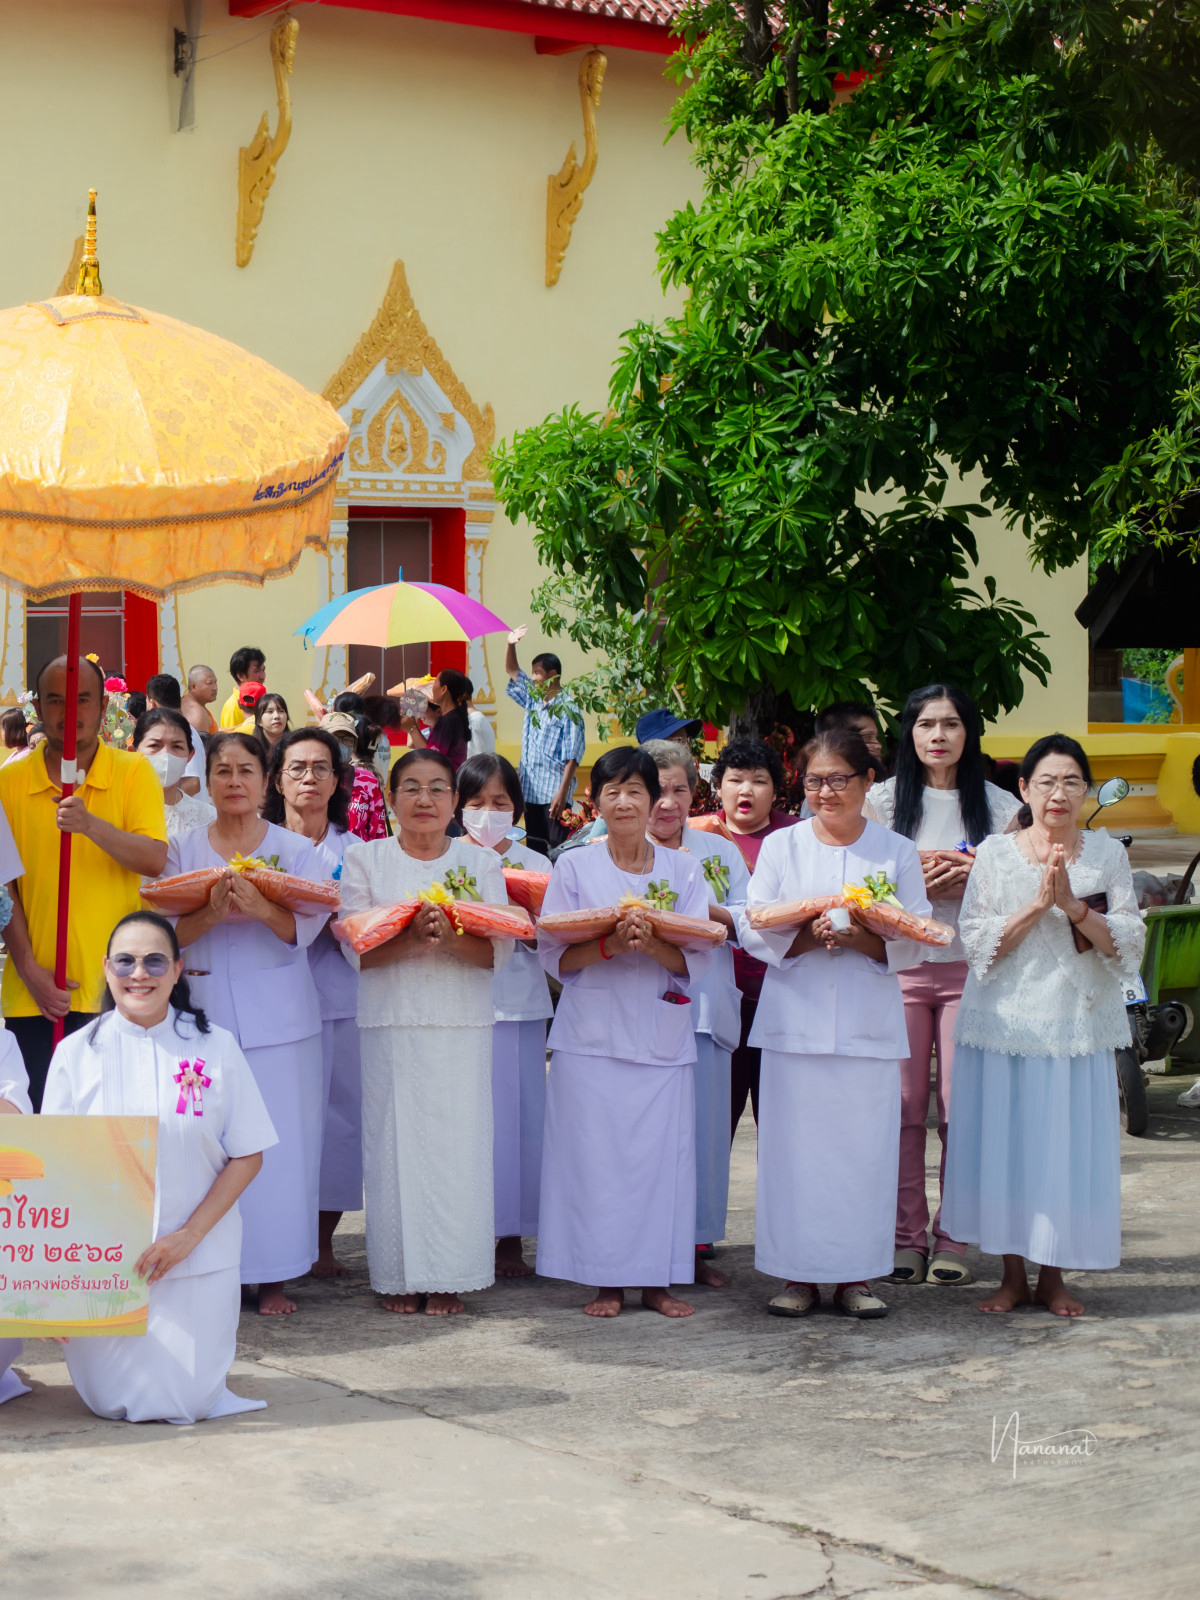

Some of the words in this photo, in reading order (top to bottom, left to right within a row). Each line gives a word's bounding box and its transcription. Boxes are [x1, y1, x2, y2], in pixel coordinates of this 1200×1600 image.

[44, 1242, 123, 1263] ๒๕๖๘
[12, 1273, 129, 1291] หลวงพ่อธัมมชโย
